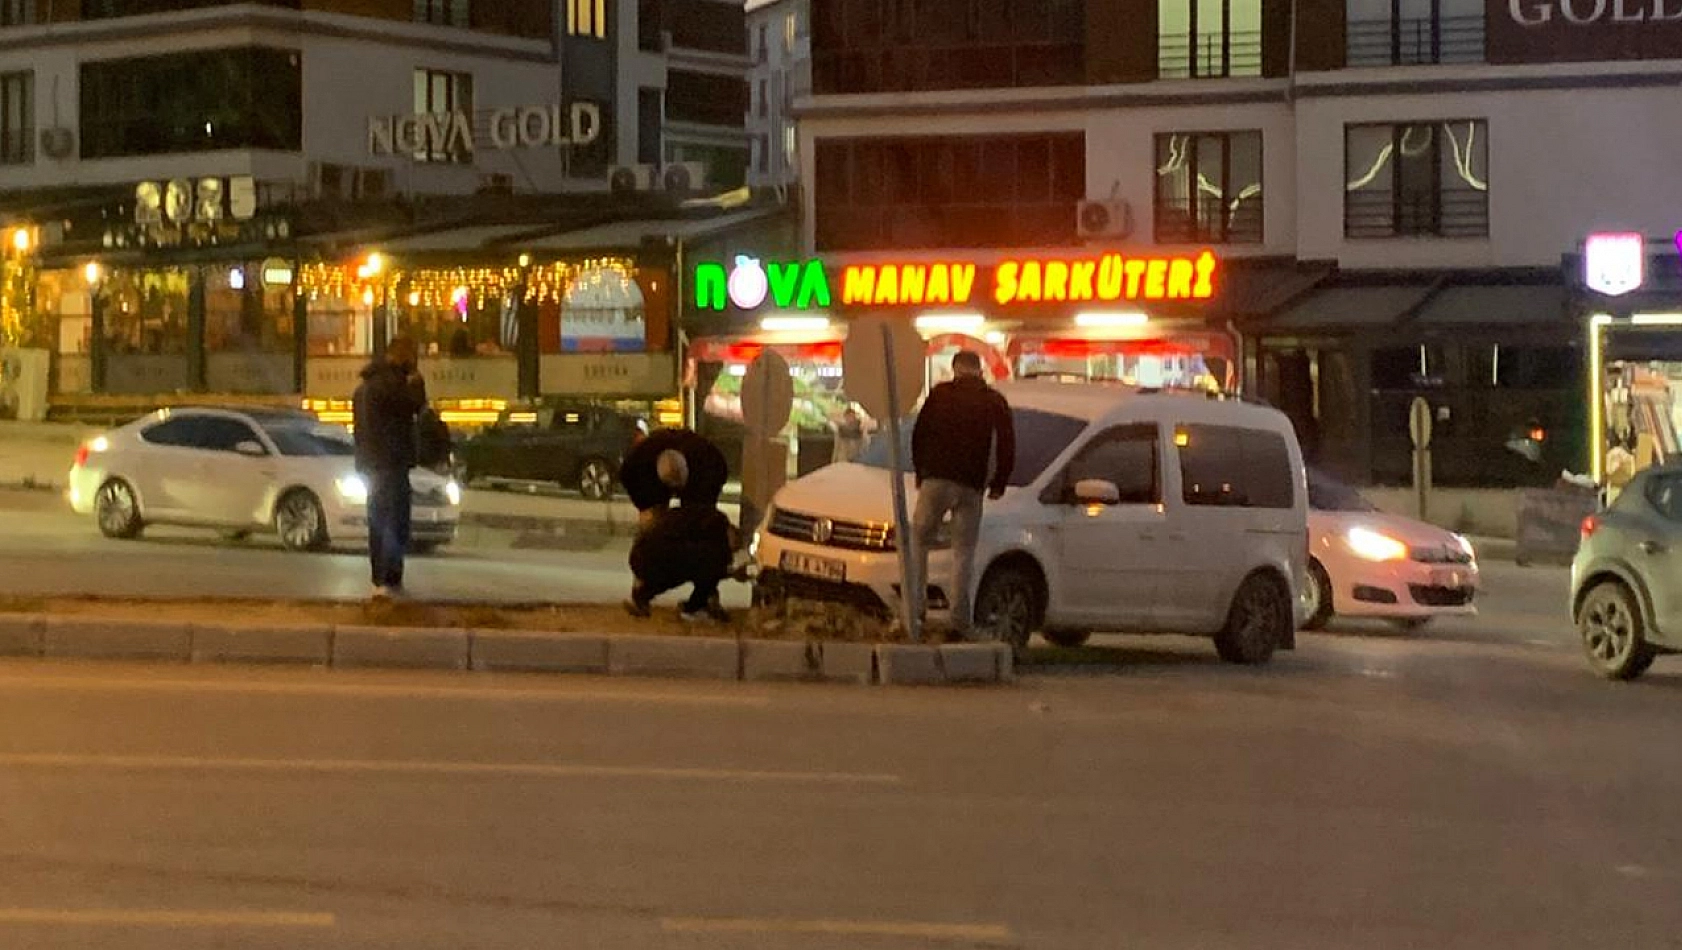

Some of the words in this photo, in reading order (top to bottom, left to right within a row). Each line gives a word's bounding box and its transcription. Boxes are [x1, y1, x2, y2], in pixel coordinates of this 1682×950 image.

[367, 109, 474, 156] NOVA
[490, 101, 600, 149] GOLD
[842, 263, 976, 306] MANAV
[995, 250, 1216, 305] ŞARKÜTERİ
